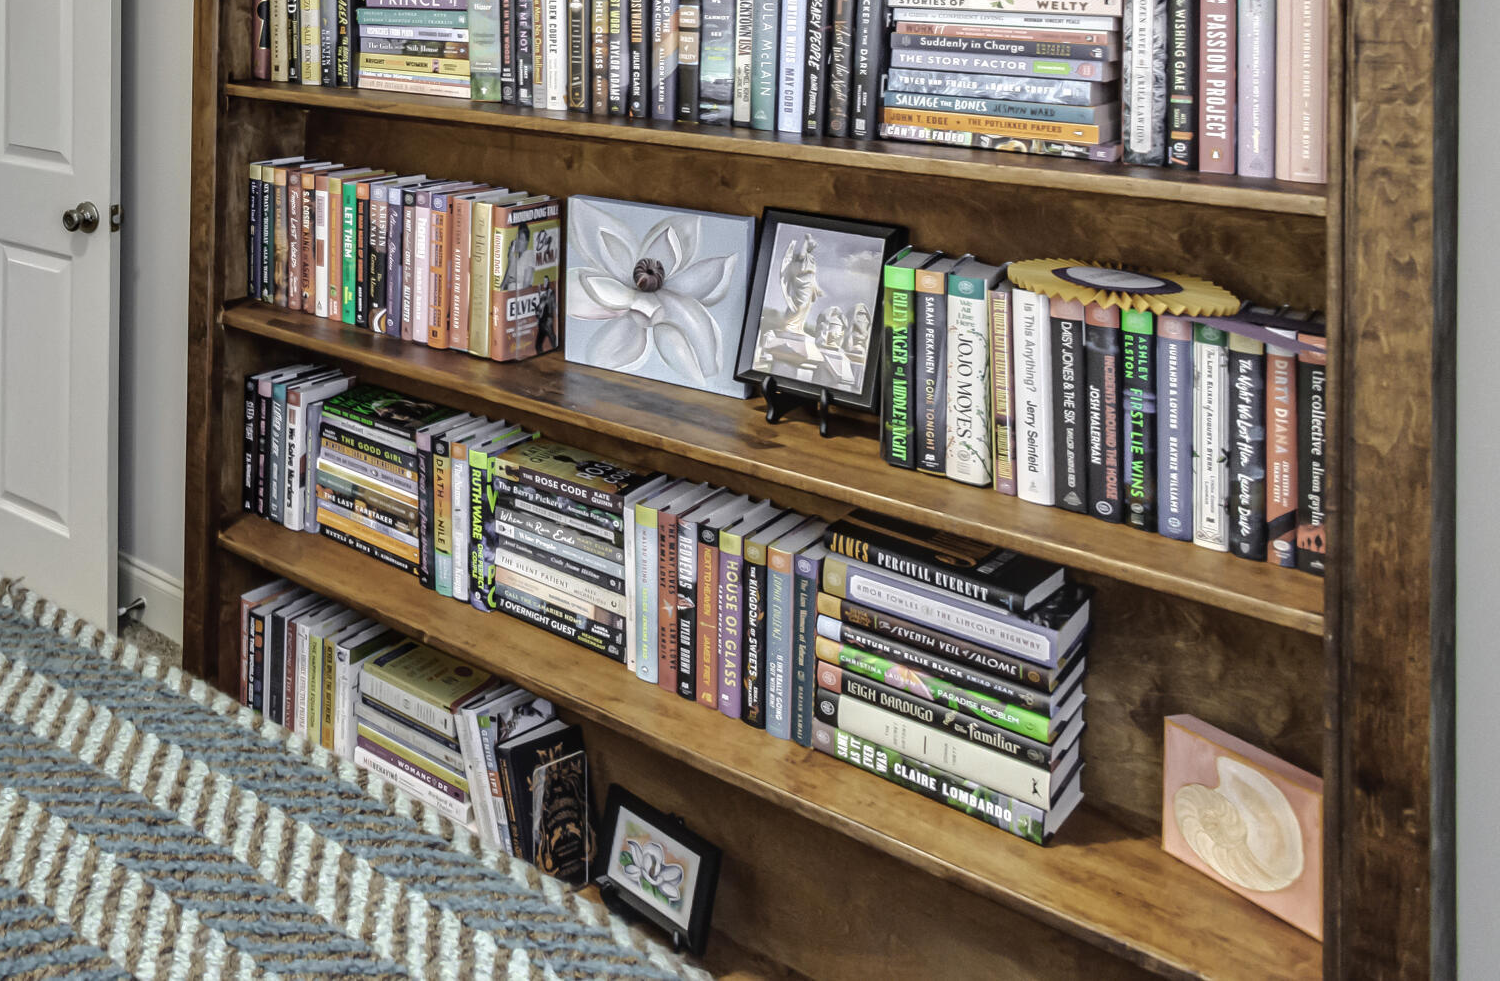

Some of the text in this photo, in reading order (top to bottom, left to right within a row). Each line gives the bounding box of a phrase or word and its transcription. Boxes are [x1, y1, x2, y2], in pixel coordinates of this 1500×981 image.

[519, 13, 527, 27] ME
[664, 6, 670, 16] OF
[1037, 1, 1088, 10] WELTY
[610, 10, 620, 34] WORD
[519, 31, 528, 52] NOT
[549, 25, 557, 54] COUPLE
[808, 29, 823, 71] PEOPLE
[920, 38, 1024, 53] Suddenly in Charge
[595, 44, 603, 68] MISS
[610, 41, 620, 70] TAYLOR
[633, 51, 641, 69] JULIE
[761, 40, 772, 96] McLAIN
[859, 49, 868, 76] DARK
[899, 54, 1026, 71] THE STORY FACTOR
[610, 73, 620, 101] ADAMS
[1205, 14, 1226, 139] PASSION PROJECT
[896, 94, 938, 107] SALVAGE
[955, 99, 987, 111] BONES
[993, 106, 1055, 117] JESMYN WARD
[890, 114, 913, 122] JOHN
[927, 115, 948, 125] EDGE
[345, 207, 353, 258] LET THEM
[510, 298, 537, 316] ELVIS
[892, 292, 908, 364] RILEY SAGER
[1124, 335, 1133, 378] ELSTON
[1137, 337, 1148, 381] ASHLEY
[925, 297, 934, 450] SARAH PEKKANEN GONE TONIGHT
[956, 333, 973, 438] JOJO MOYES
[1018, 303, 1039, 472] Is This Anything? Jerry Seinfeld
[1312, 371, 1325, 392] the
[1273, 361, 1288, 454] DIRTY DIANA
[1090, 385, 1102, 465] JOSH MALERMAN
[1311, 395, 1326, 455] collective
[341, 435, 402, 464] THE GOOD GIRL
[1130, 389, 1143, 498] FIRST LIE WINS
[286, 428, 296, 507] We Solve Murders
[436, 459, 444, 499] DEATH
[1311, 460, 1325, 489] alison
[324, 492, 336, 503] THE
[338, 497, 353, 509] LAST
[535, 474, 558, 490] ROSE
[560, 483, 587, 498] CODE
[594, 491, 610, 501] KATE
[472, 469, 482, 540] RUTH WARE
[591, 496, 613, 508] QUINN
[830, 532, 869, 563] JAMES
[500, 556, 568, 588] THE SILENT PATIENT
[878, 552, 989, 601] PERCIVAL EVERETT
[505, 600, 576, 636] OVERNIGHT GUEST
[679, 535, 692, 675] REDNECKS TAYLOR BROWN
[748, 579, 758, 628] KINGDOM
[857, 585, 1041, 650] AMOR TOWLES THE LINCOLN HIGHWAY
[725, 561, 739, 687] HOUSE OF GLASS
[746, 635, 758, 676] SWEETS
[847, 681, 933, 722] LEIGH BARDUGO
[937, 689, 1020, 724] PARADISE PROBLEM
[480, 729, 492, 770] GENIUS
[836, 730, 848, 758] SAME
[967, 724, 1020, 754] Familiar
[863, 744, 874, 769] EVER
[876, 751, 887, 773] WAS
[489, 773, 498, 795] LIFE
[894, 763, 1012, 821] CLAIRE LOMBARDO
